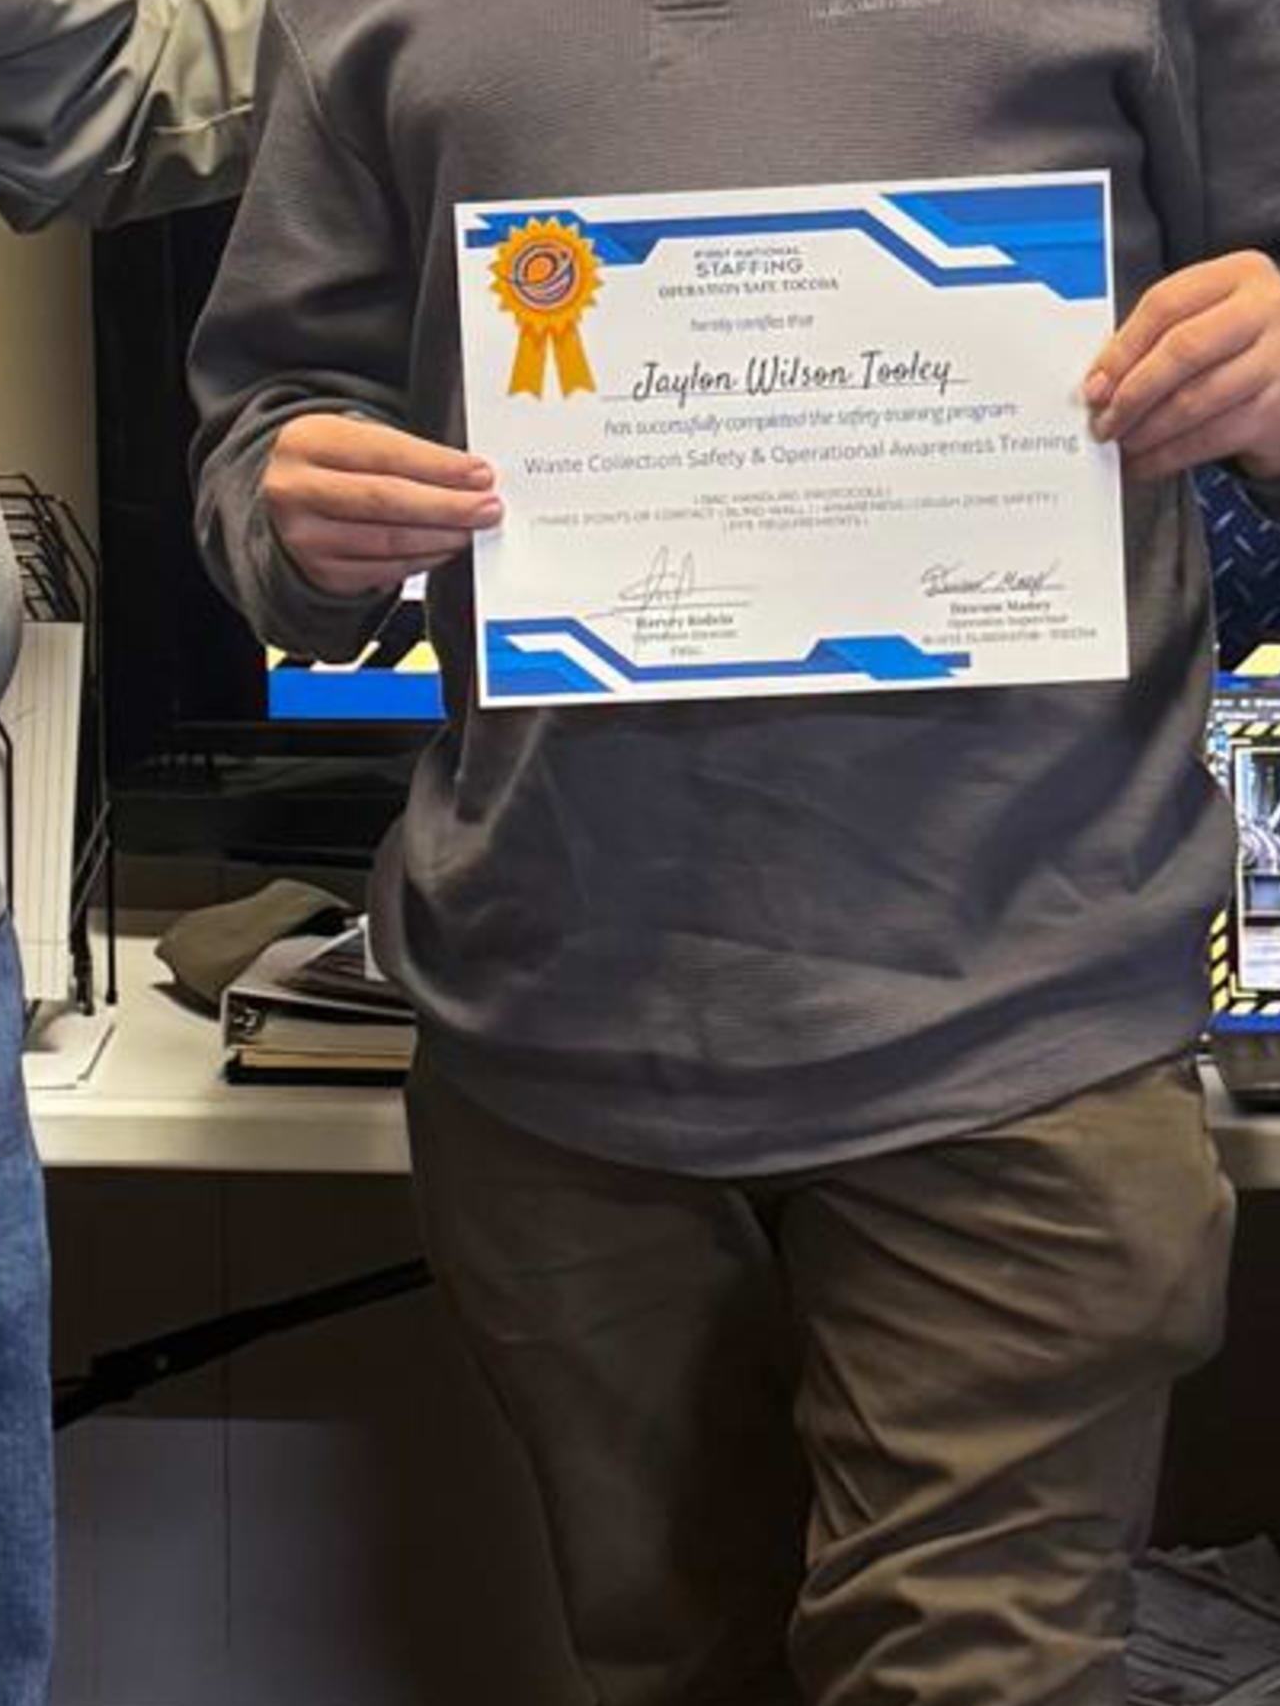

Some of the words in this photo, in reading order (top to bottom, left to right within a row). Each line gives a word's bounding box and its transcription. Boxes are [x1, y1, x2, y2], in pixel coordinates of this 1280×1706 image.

[695, 257, 804, 279] STAFFING
[746, 355, 850, 396] Wilson
[523, 456, 584, 475] Waste
[686, 447, 745, 469] Safety
[751, 446, 766, 463] &
[770, 440, 885, 469] Operational
[889, 435, 996, 459] Awareness
